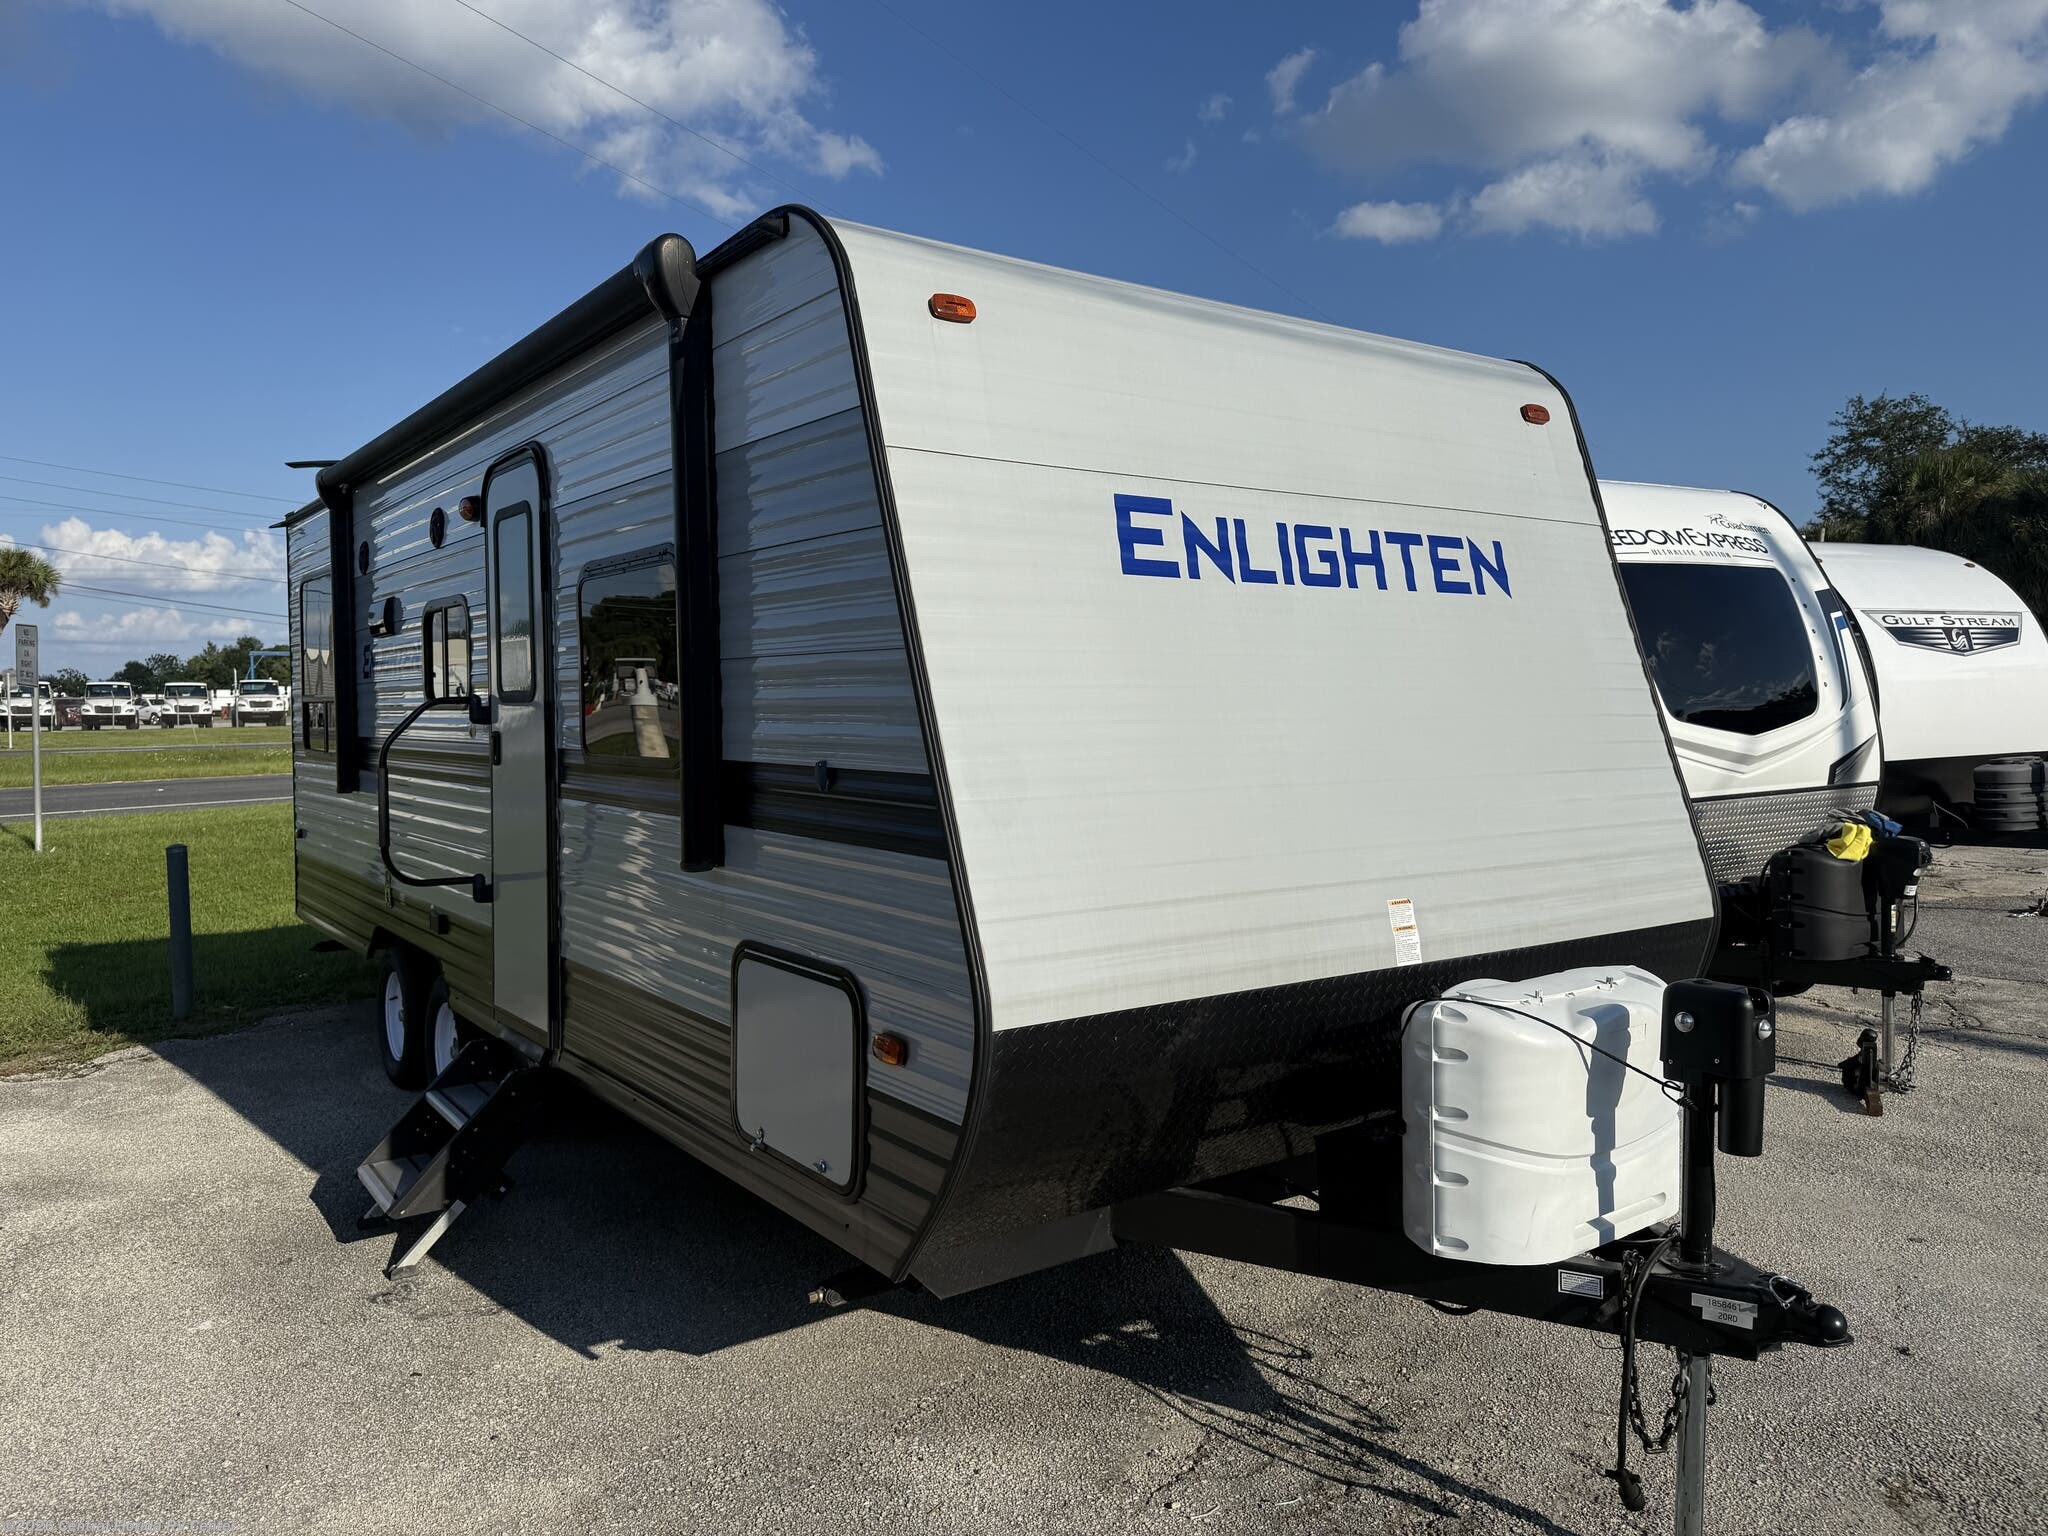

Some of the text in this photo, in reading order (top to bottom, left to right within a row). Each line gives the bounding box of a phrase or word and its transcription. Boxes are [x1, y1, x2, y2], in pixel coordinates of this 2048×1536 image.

[1114, 493, 1512, 598] ENLIGHTEN
[1881, 614, 2016, 626] GULF STREAM
[1718, 1312, 1738, 1323] 20RD
